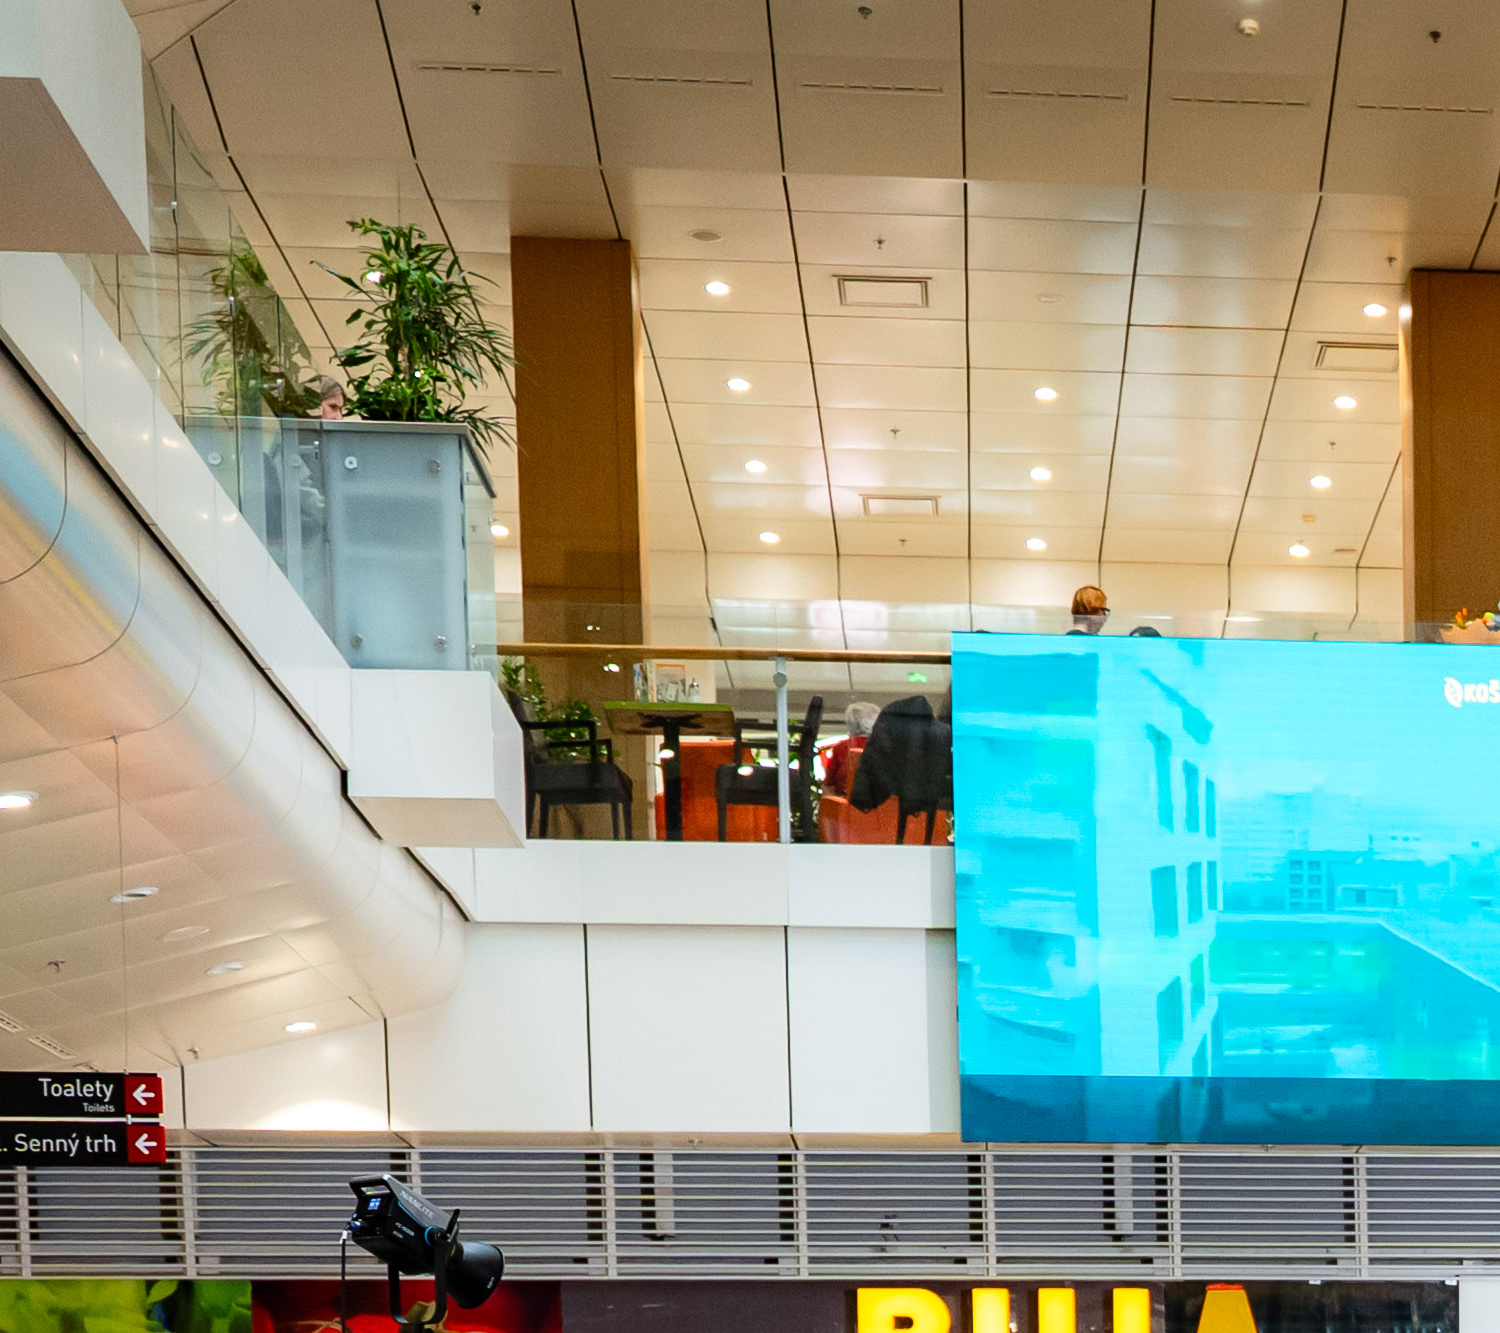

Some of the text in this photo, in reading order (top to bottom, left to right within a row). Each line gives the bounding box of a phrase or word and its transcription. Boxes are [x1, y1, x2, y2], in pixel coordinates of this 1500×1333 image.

[38, 1078, 114, 1102] Toalety
[83, 1102, 115, 1113] Toilets
[15, 1133, 79, 1157] Senný
[85, 1134, 116, 1153] trh
